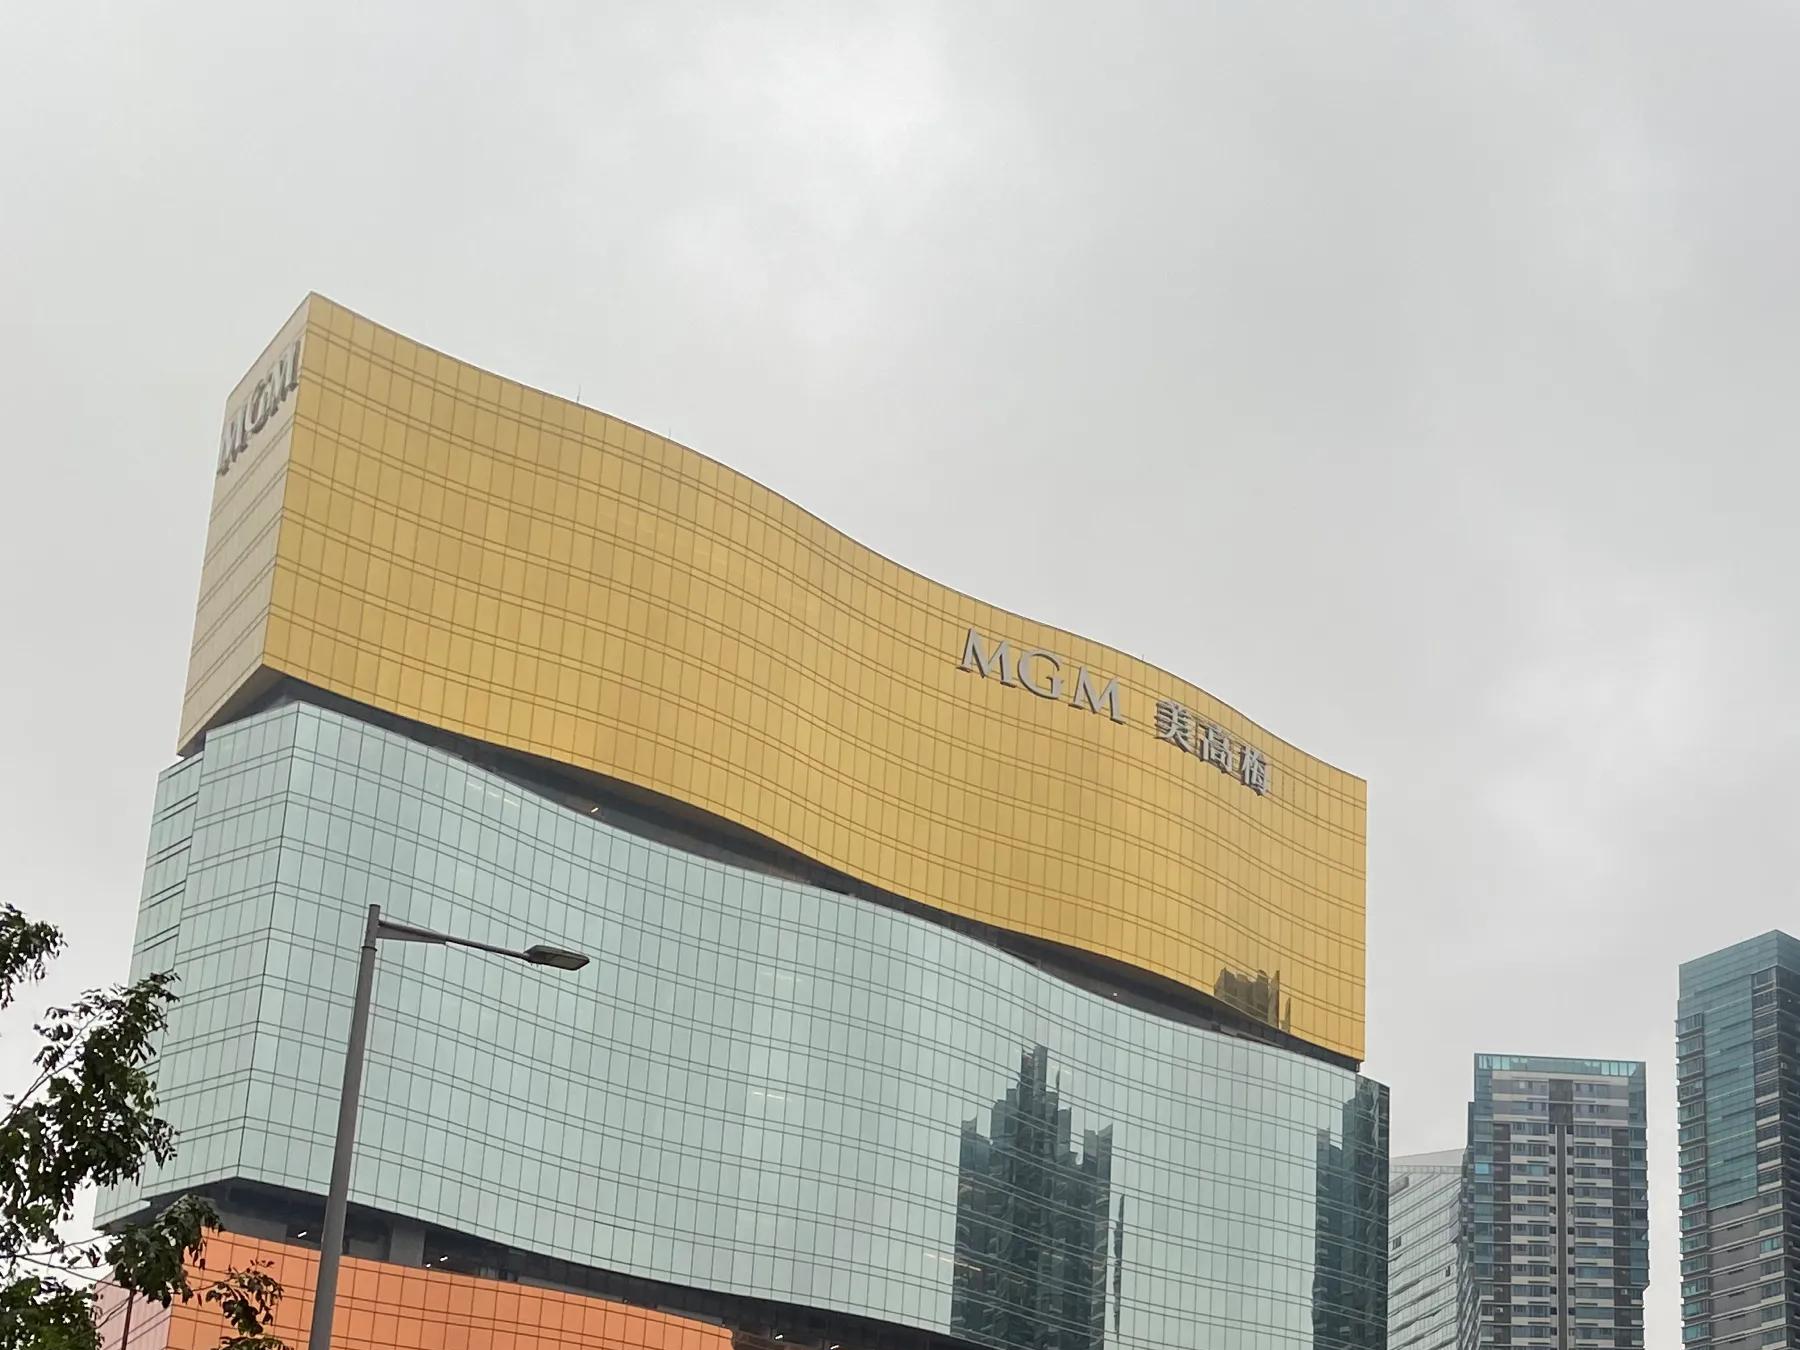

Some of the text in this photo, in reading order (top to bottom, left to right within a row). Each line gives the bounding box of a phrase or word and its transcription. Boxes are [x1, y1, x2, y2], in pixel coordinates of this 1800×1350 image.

[217, 339, 302, 476] MGM
[956, 626, 1270, 796] MGM 美高梅
